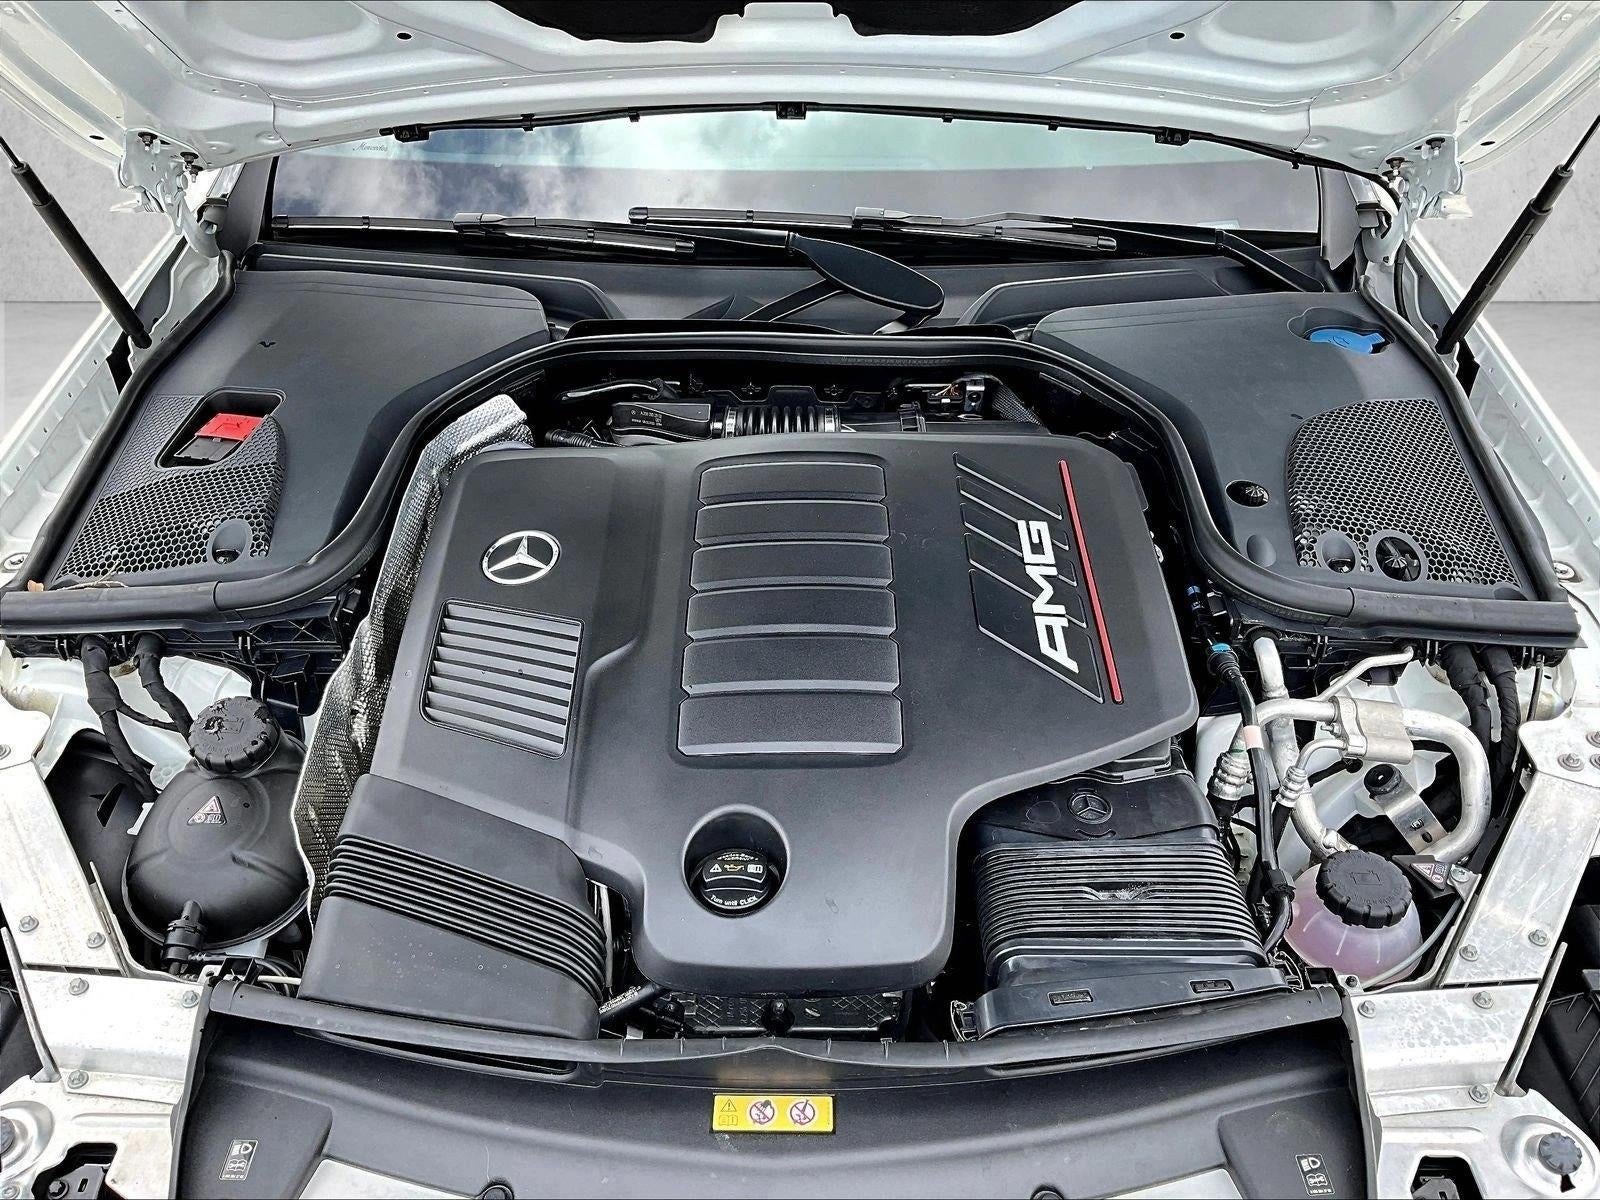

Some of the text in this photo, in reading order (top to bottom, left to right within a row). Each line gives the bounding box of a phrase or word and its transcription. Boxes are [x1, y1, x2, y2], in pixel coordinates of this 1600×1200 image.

[1017, 519, 1080, 674] AMG
[710, 894, 723, 904] Turn
[739, 894, 758, 906] CLICK
